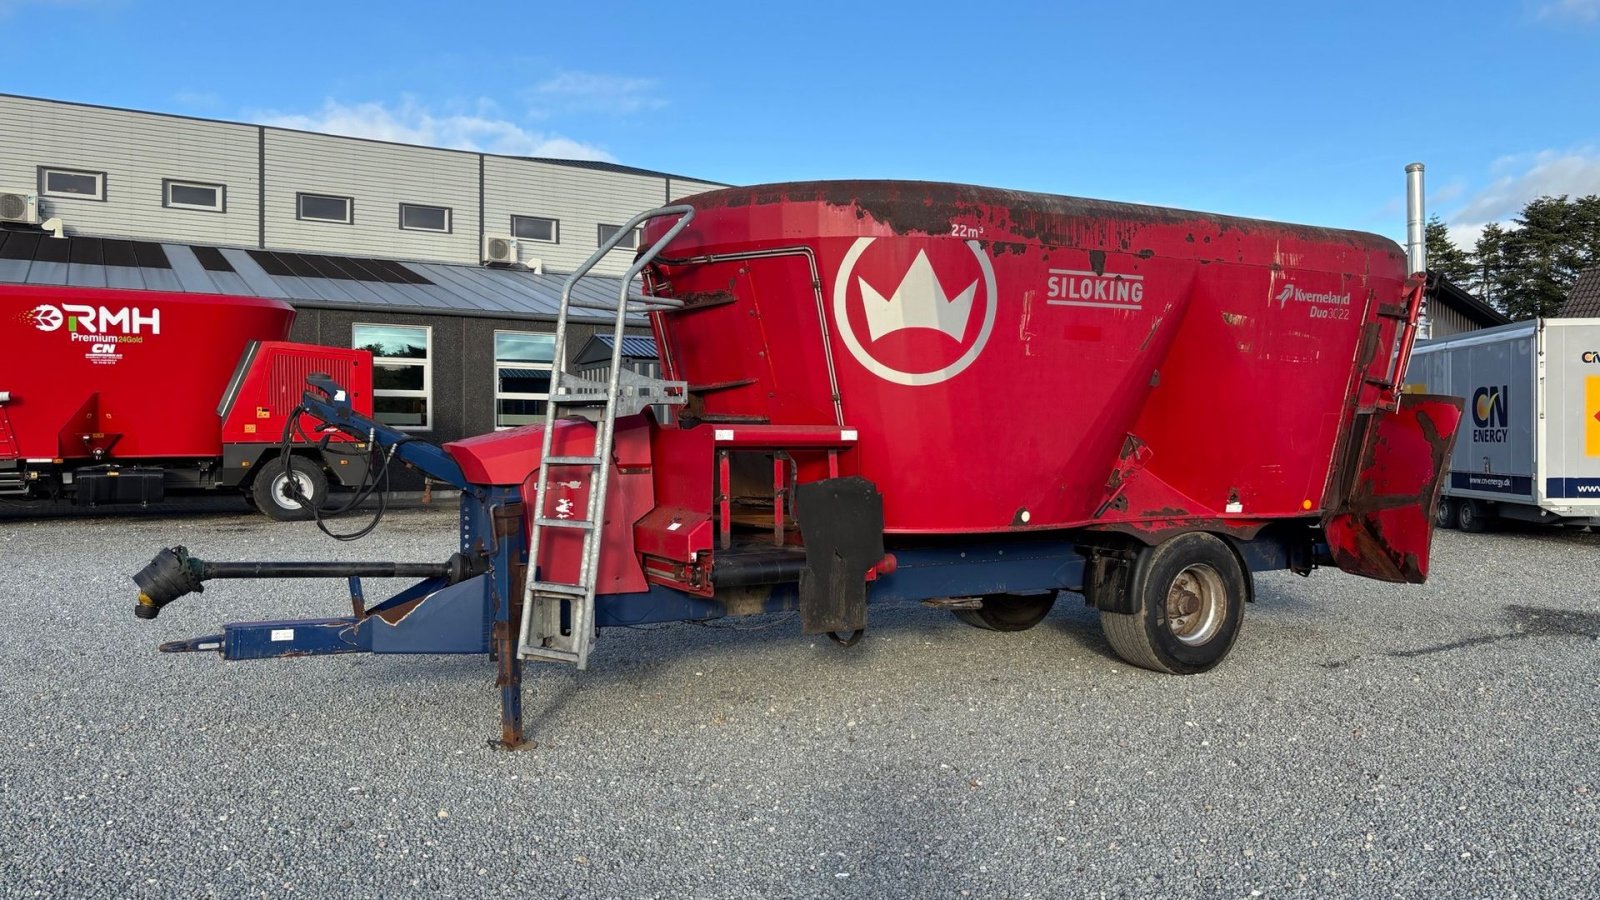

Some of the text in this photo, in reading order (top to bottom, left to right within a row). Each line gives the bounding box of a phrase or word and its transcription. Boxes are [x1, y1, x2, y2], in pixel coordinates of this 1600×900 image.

[1046, 276, 1144, 304] SILOKING
[1295, 288, 1351, 305] Kverneland
[62, 303, 161, 334] RMH
[92, 344, 117, 354] CN
[1472, 385, 1508, 428] CN
[1473, 428, 1508, 443] ENERGY
